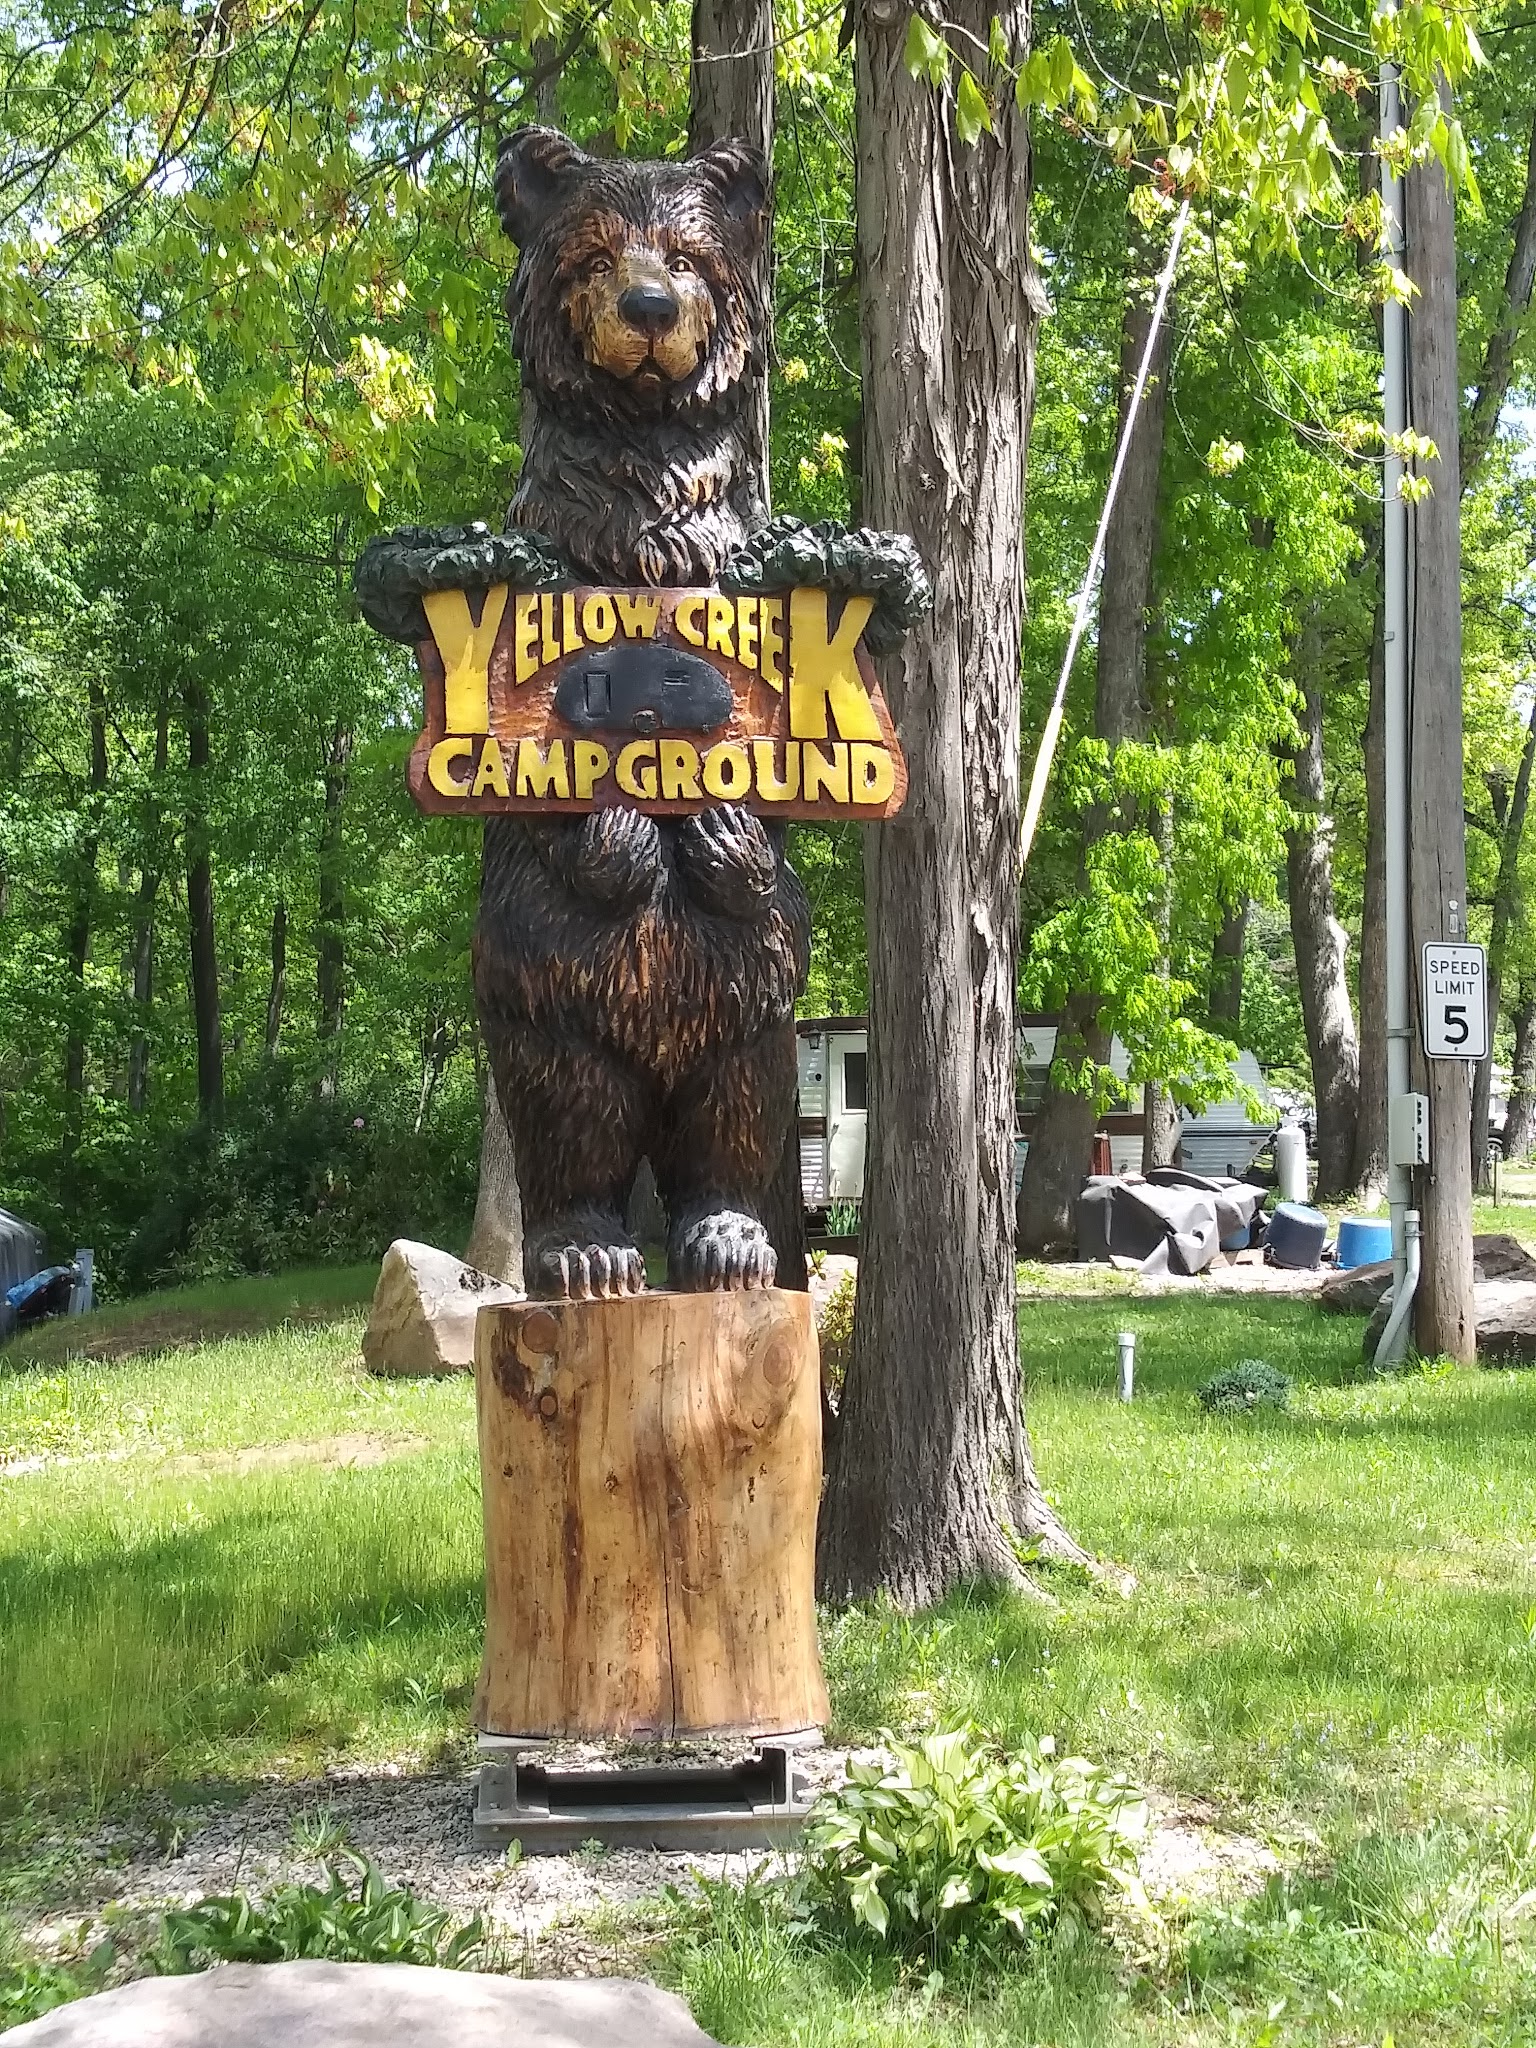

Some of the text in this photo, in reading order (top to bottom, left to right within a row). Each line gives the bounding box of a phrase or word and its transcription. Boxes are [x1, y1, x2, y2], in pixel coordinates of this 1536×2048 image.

[422, 583, 883, 740] YELLOW CREEK
[427, 737, 895, 804] CAMPGROUND
[1430, 960, 1480, 976] SPEED
[1435, 981, 1475, 995] LIMIT
[1443, 1005, 1469, 1044] 5
